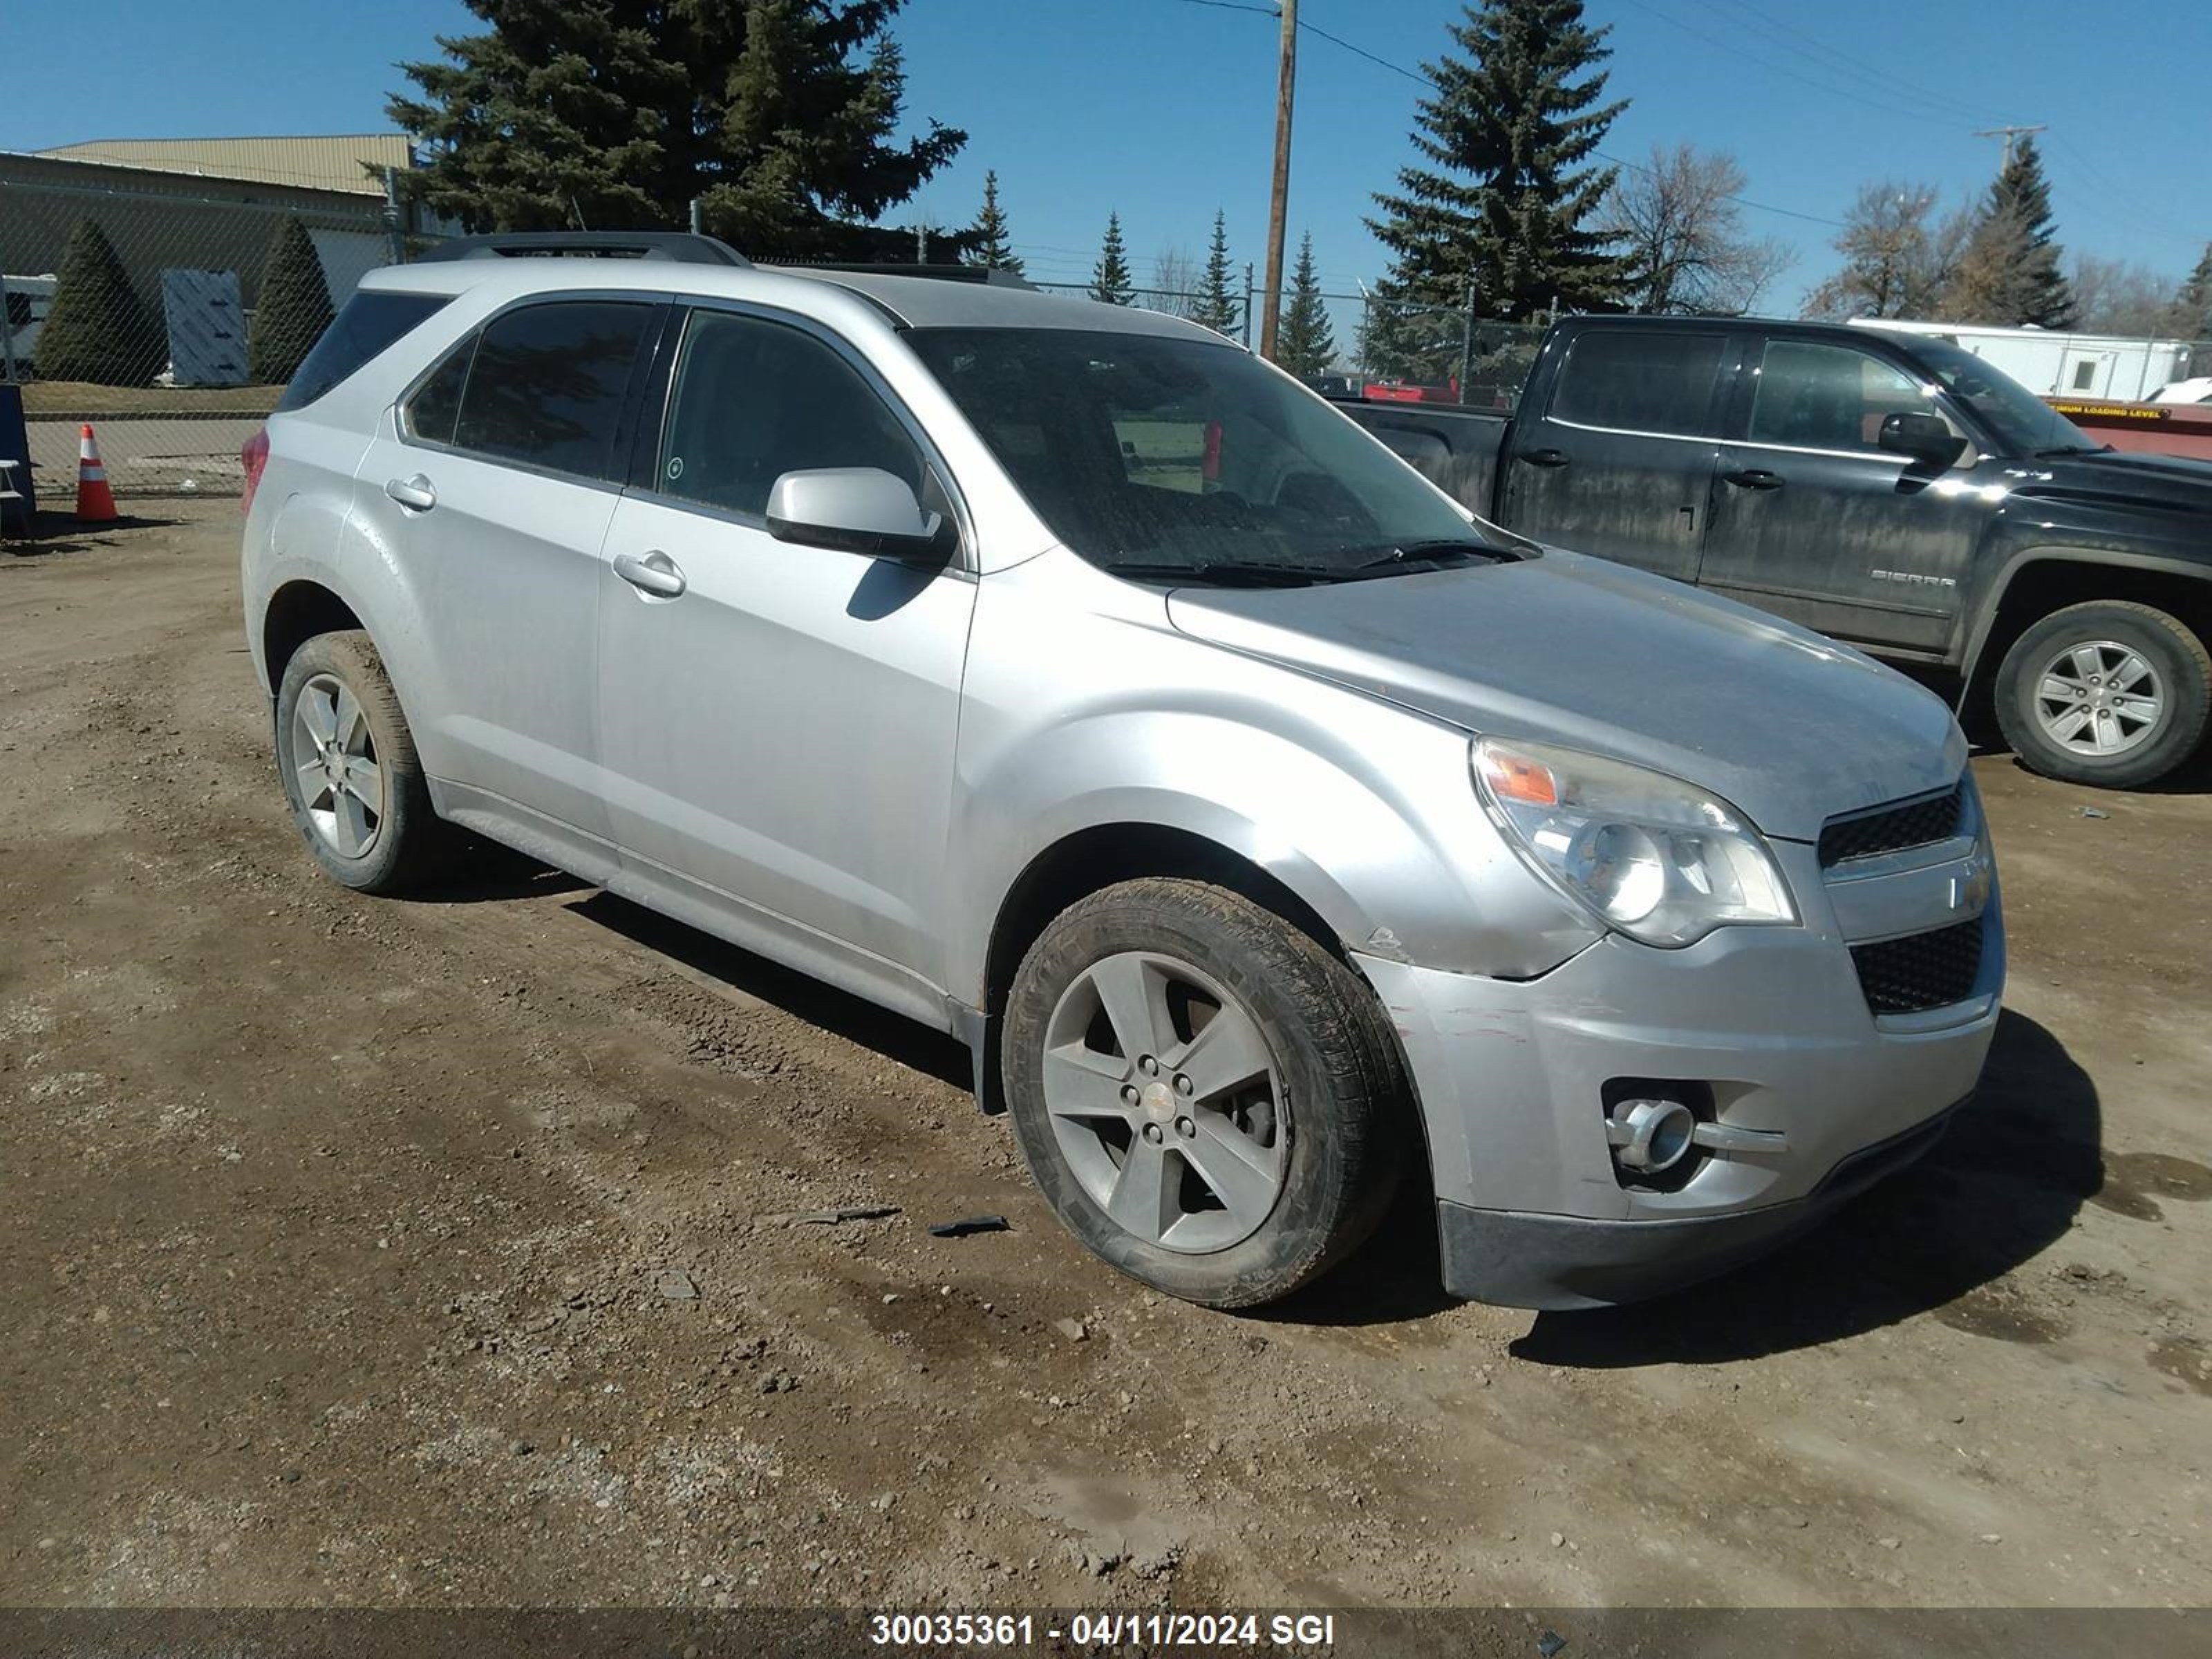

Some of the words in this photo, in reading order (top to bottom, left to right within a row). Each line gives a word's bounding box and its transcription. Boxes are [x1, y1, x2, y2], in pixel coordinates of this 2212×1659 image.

[2083, 406, 2127, 415] LOADING
[2130, 409, 2161, 418] LEVEL
[1871, 570, 1957, 586] SIERRA
